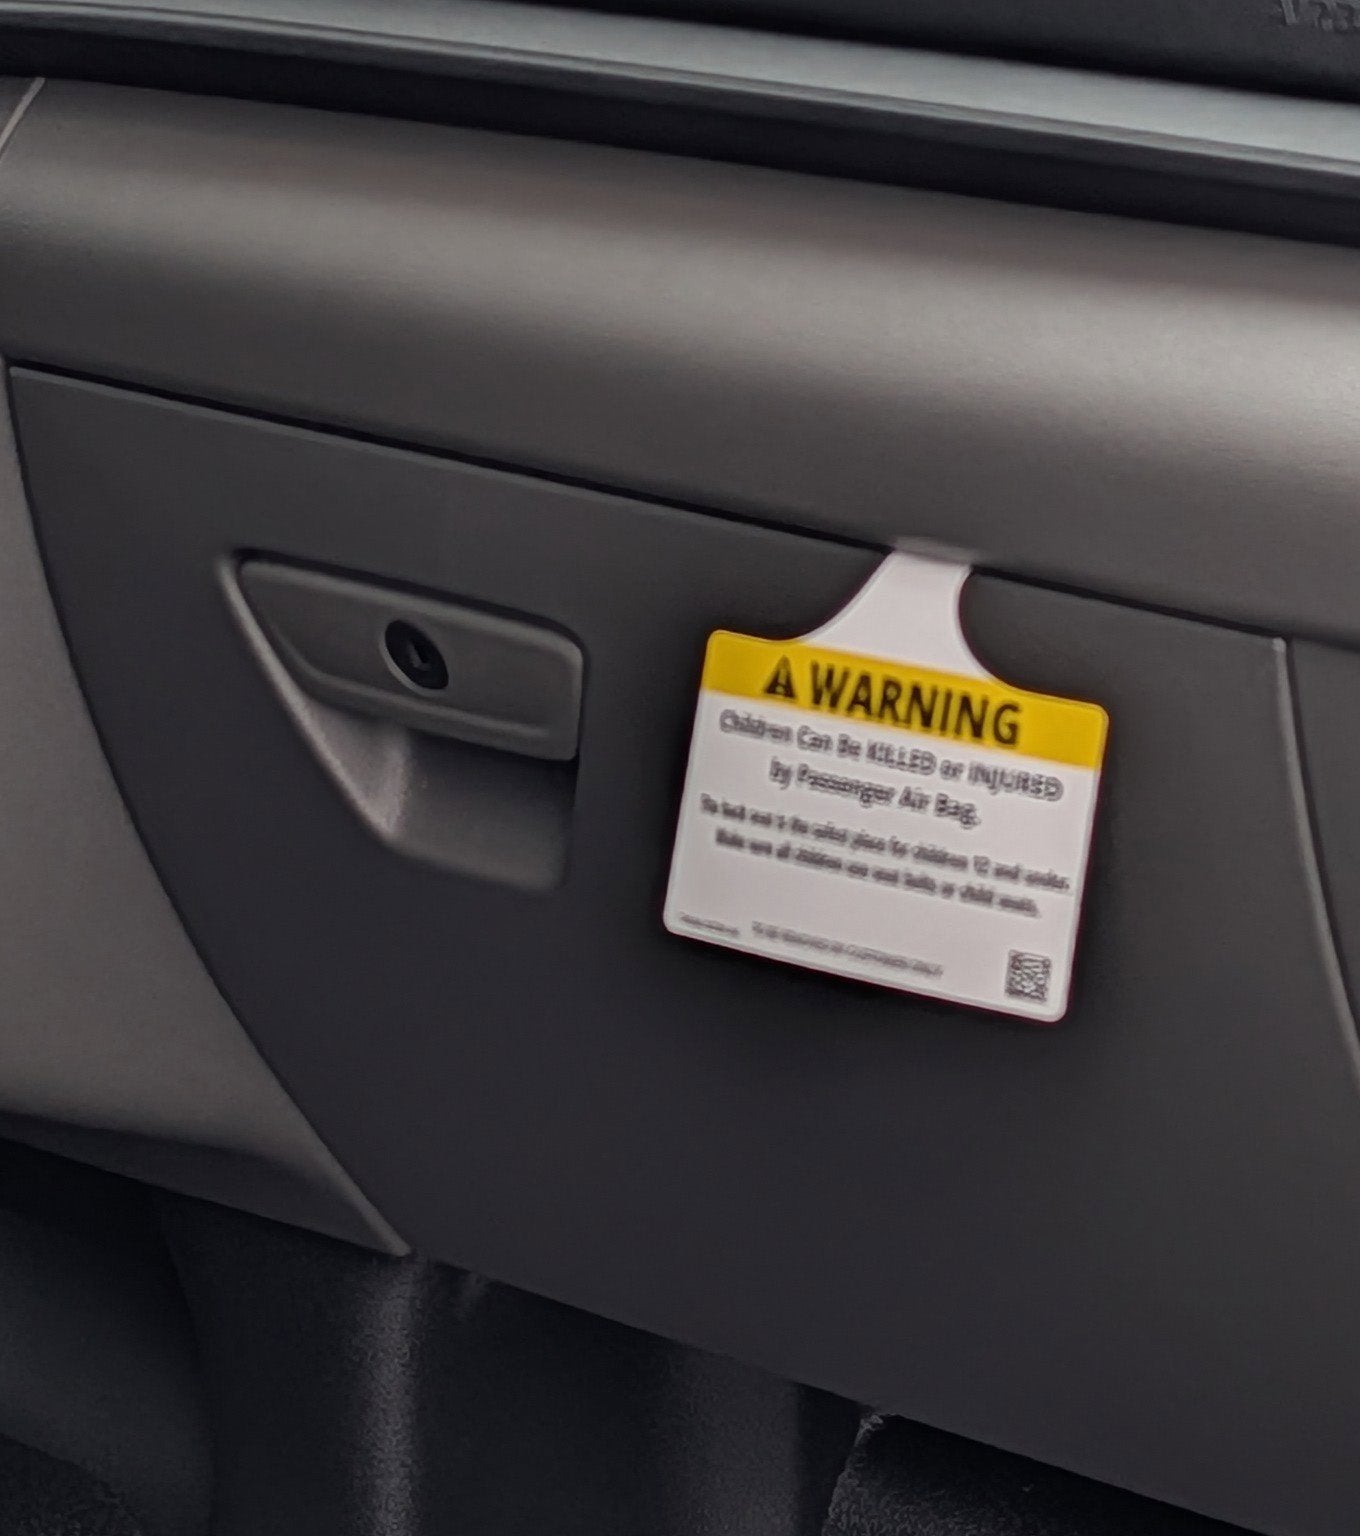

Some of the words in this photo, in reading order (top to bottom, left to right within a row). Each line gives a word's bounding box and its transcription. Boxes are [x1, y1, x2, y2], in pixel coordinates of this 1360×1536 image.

[810, 659, 1022, 749] WARNING
[719, 709, 793, 745] Children
[797, 725, 833, 752] Can
[837, 733, 862, 760] Be
[866, 739, 937, 776] KILLED
[940, 759, 964, 781] or
[967, 762, 1064, 802] INJURED
[769, 755, 792, 790] by
[797, 763, 896, 808] Passenger
[898, 786, 931, 814] Air
